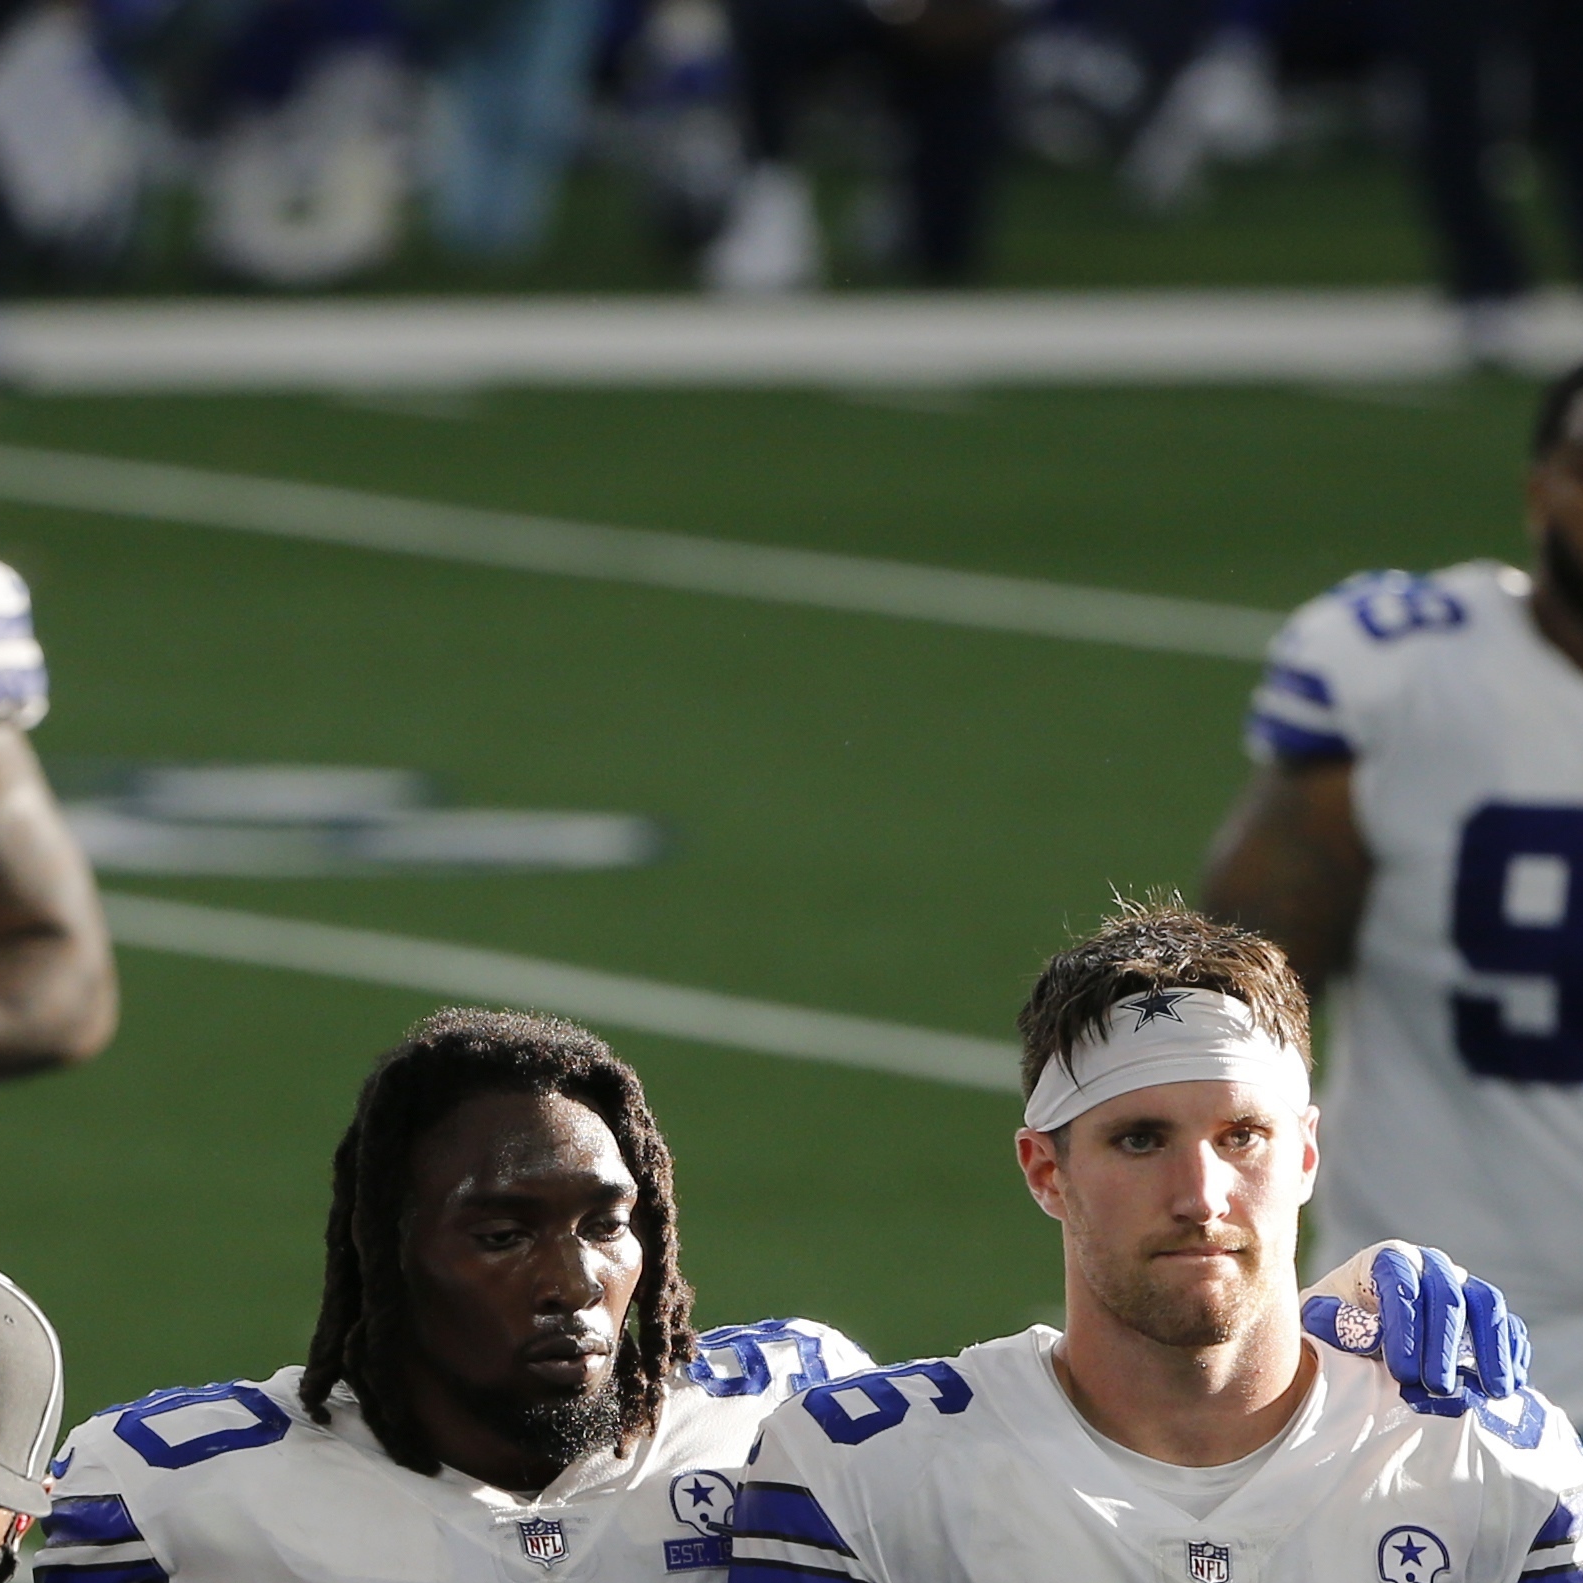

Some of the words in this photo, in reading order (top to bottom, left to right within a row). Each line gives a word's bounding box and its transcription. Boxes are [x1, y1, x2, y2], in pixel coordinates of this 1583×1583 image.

[526, 1534, 559, 1553] NFL
[669, 1543, 711, 1564] EST.
[1192, 1557, 1226, 1581] NFL
